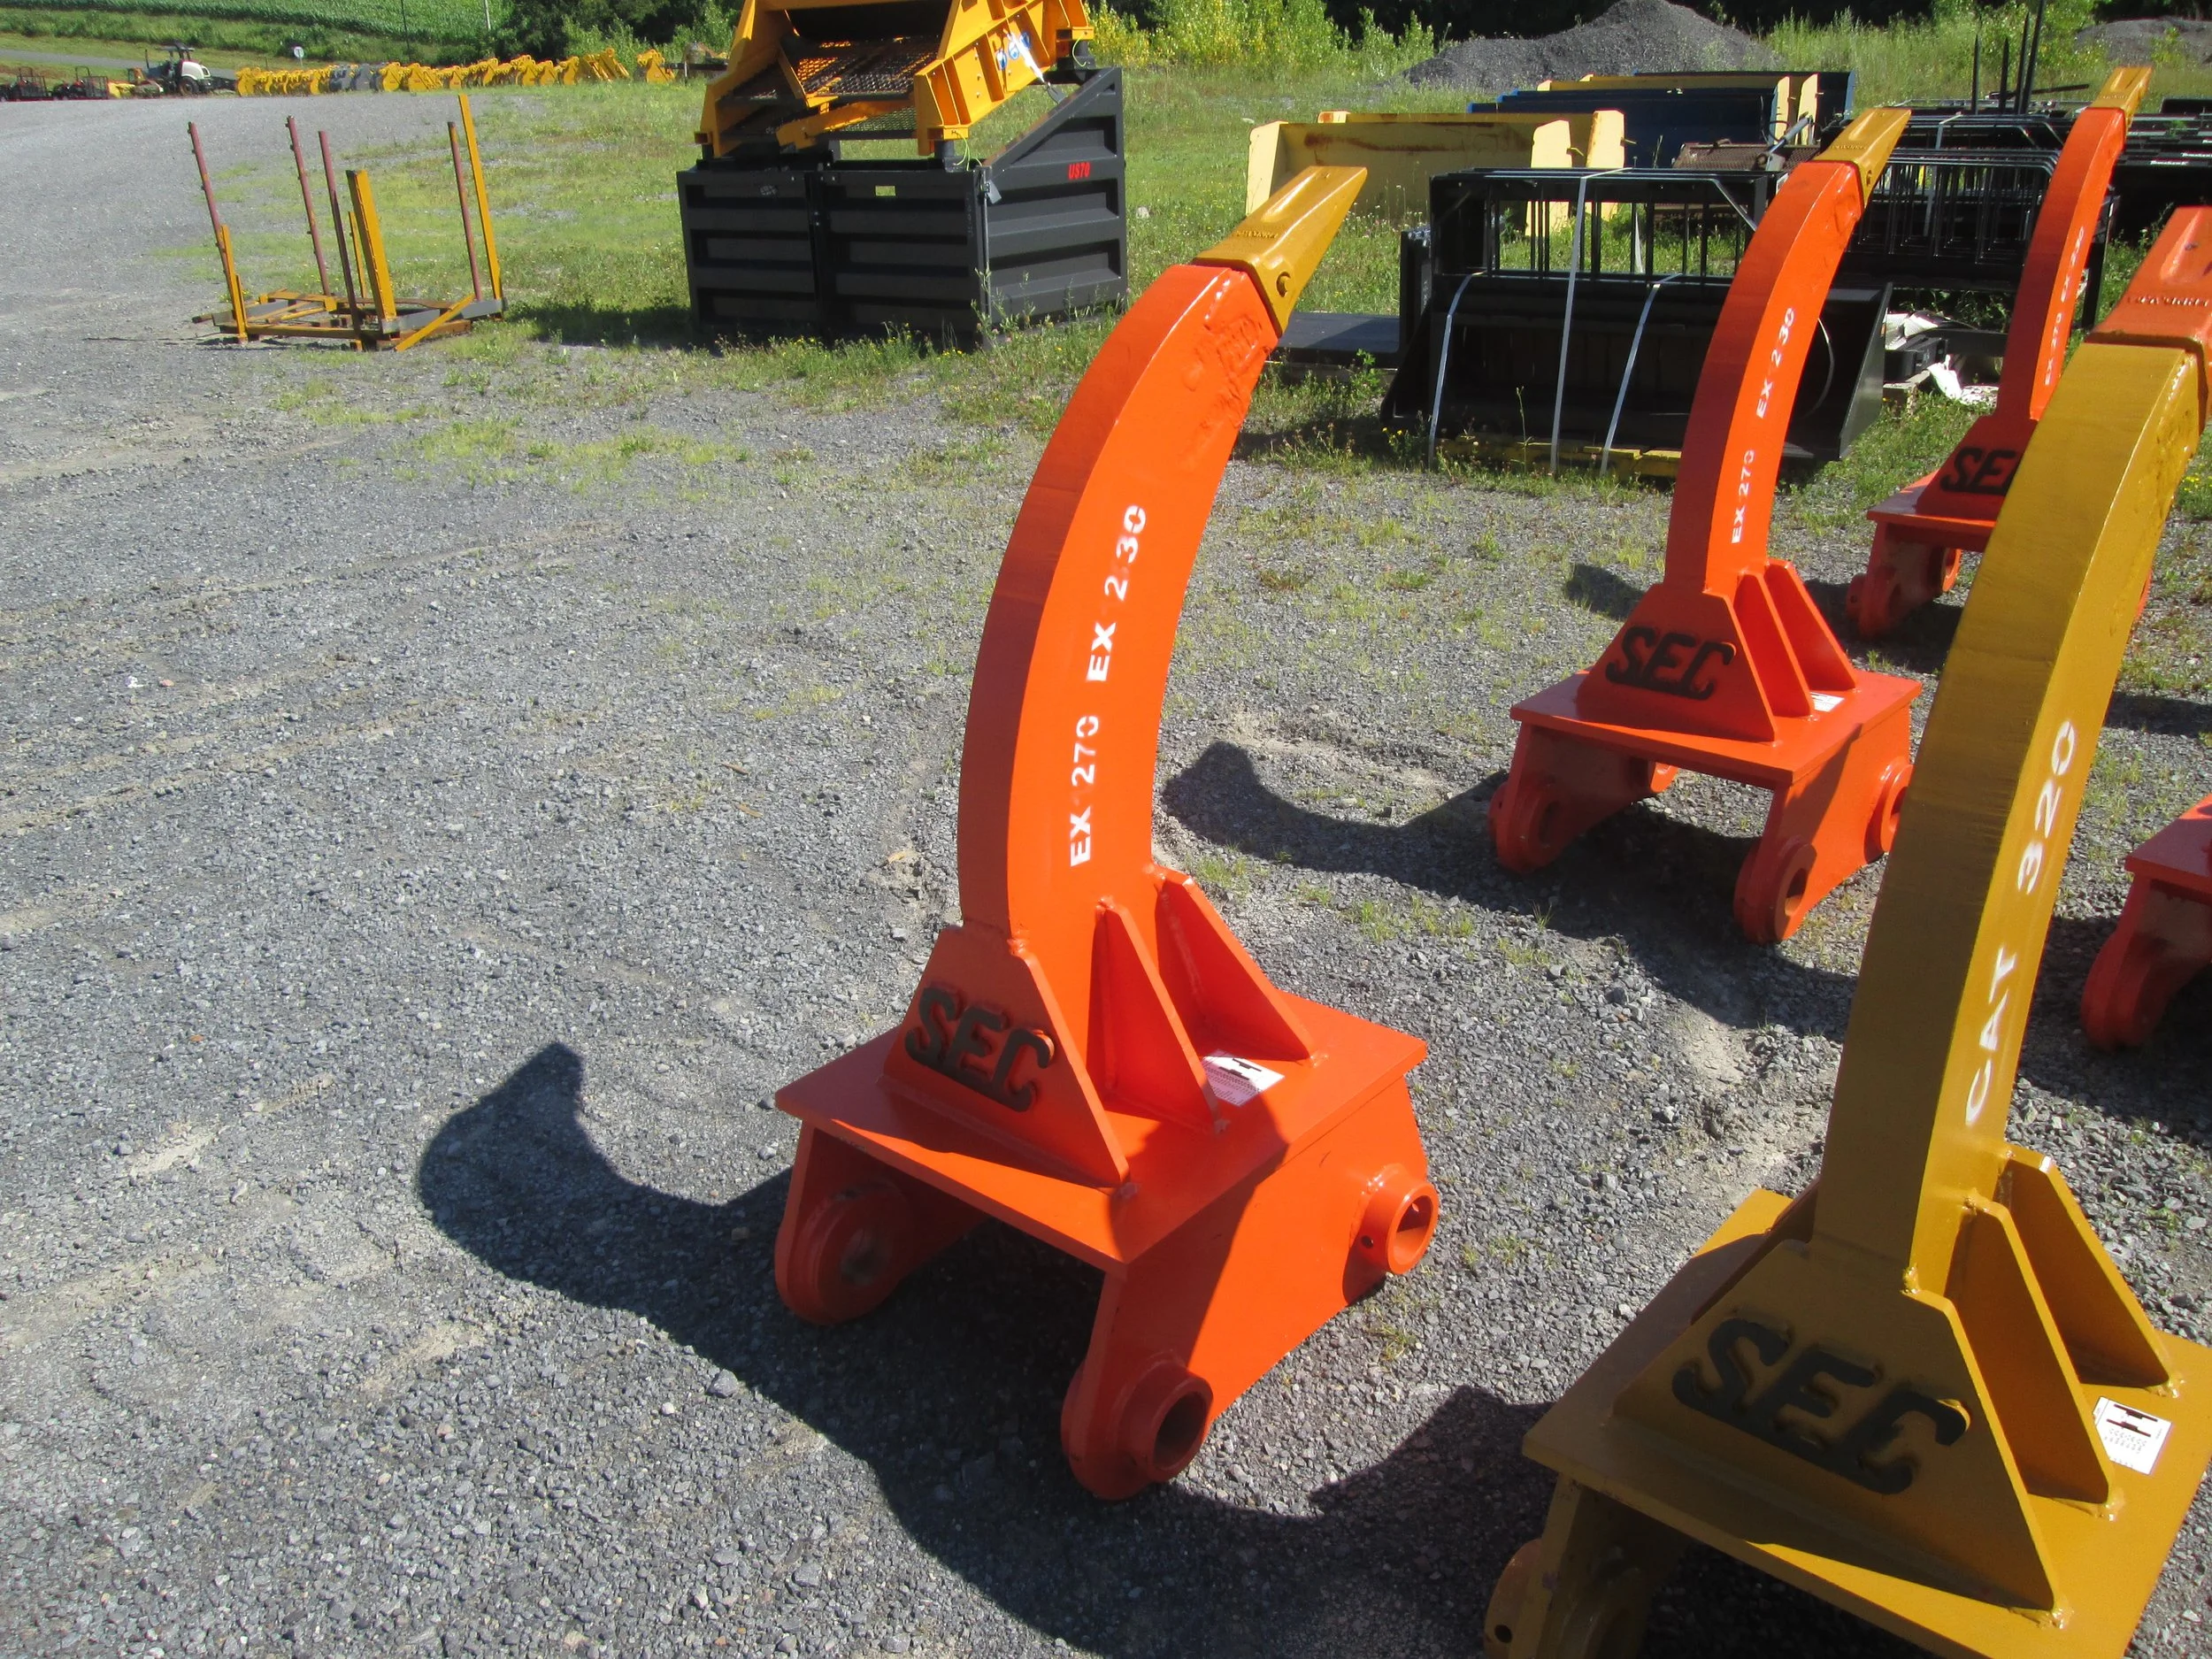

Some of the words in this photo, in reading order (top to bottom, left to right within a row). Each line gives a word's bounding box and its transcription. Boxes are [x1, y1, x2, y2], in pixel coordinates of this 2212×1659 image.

[1755, 378, 1774, 419] EX
[1738, 449, 1755, 499] 270
[1939, 447, 2024, 496] SE
[1731, 505, 1746, 545] EX
[1086, 621, 1118, 682] EX
[1605, 626, 1737, 701] SEC
[1071, 715, 1099, 787] 270
[1070, 805, 1092, 868] EX
[1965, 944, 2017, 1126] CAT
[2016, 719, 2077, 896] 320
[904, 986, 1056, 1113] SEC
[1671, 1316, 1971, 1495] SEC
